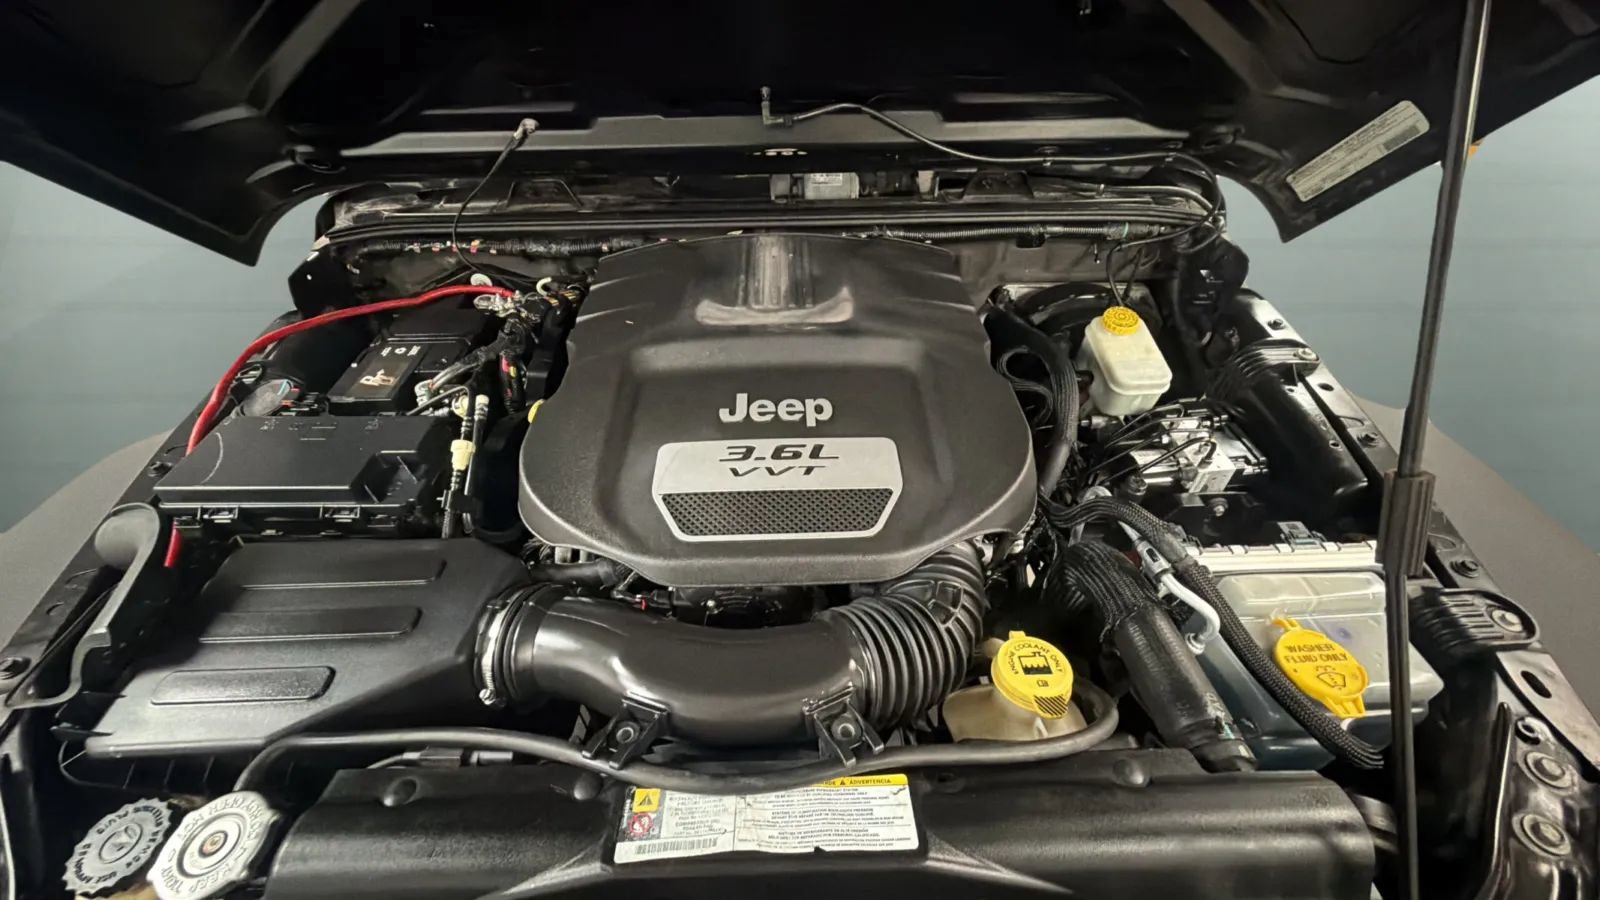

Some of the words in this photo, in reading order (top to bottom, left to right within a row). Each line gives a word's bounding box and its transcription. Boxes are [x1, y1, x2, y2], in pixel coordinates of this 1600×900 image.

[719, 393, 833, 427] Jeep
[719, 444, 839, 462] 3.6L
[729, 465, 827, 477] VVT
[1286, 643, 1335, 653] WASHER
[1014, 643, 1050, 654] COOLANT
[1050, 655, 1064, 672] ONLY
[1284, 655, 1318, 664] FLUID
[1319, 652, 1348, 662] ONLY
[161, 866, 184, 893] TIGHT
